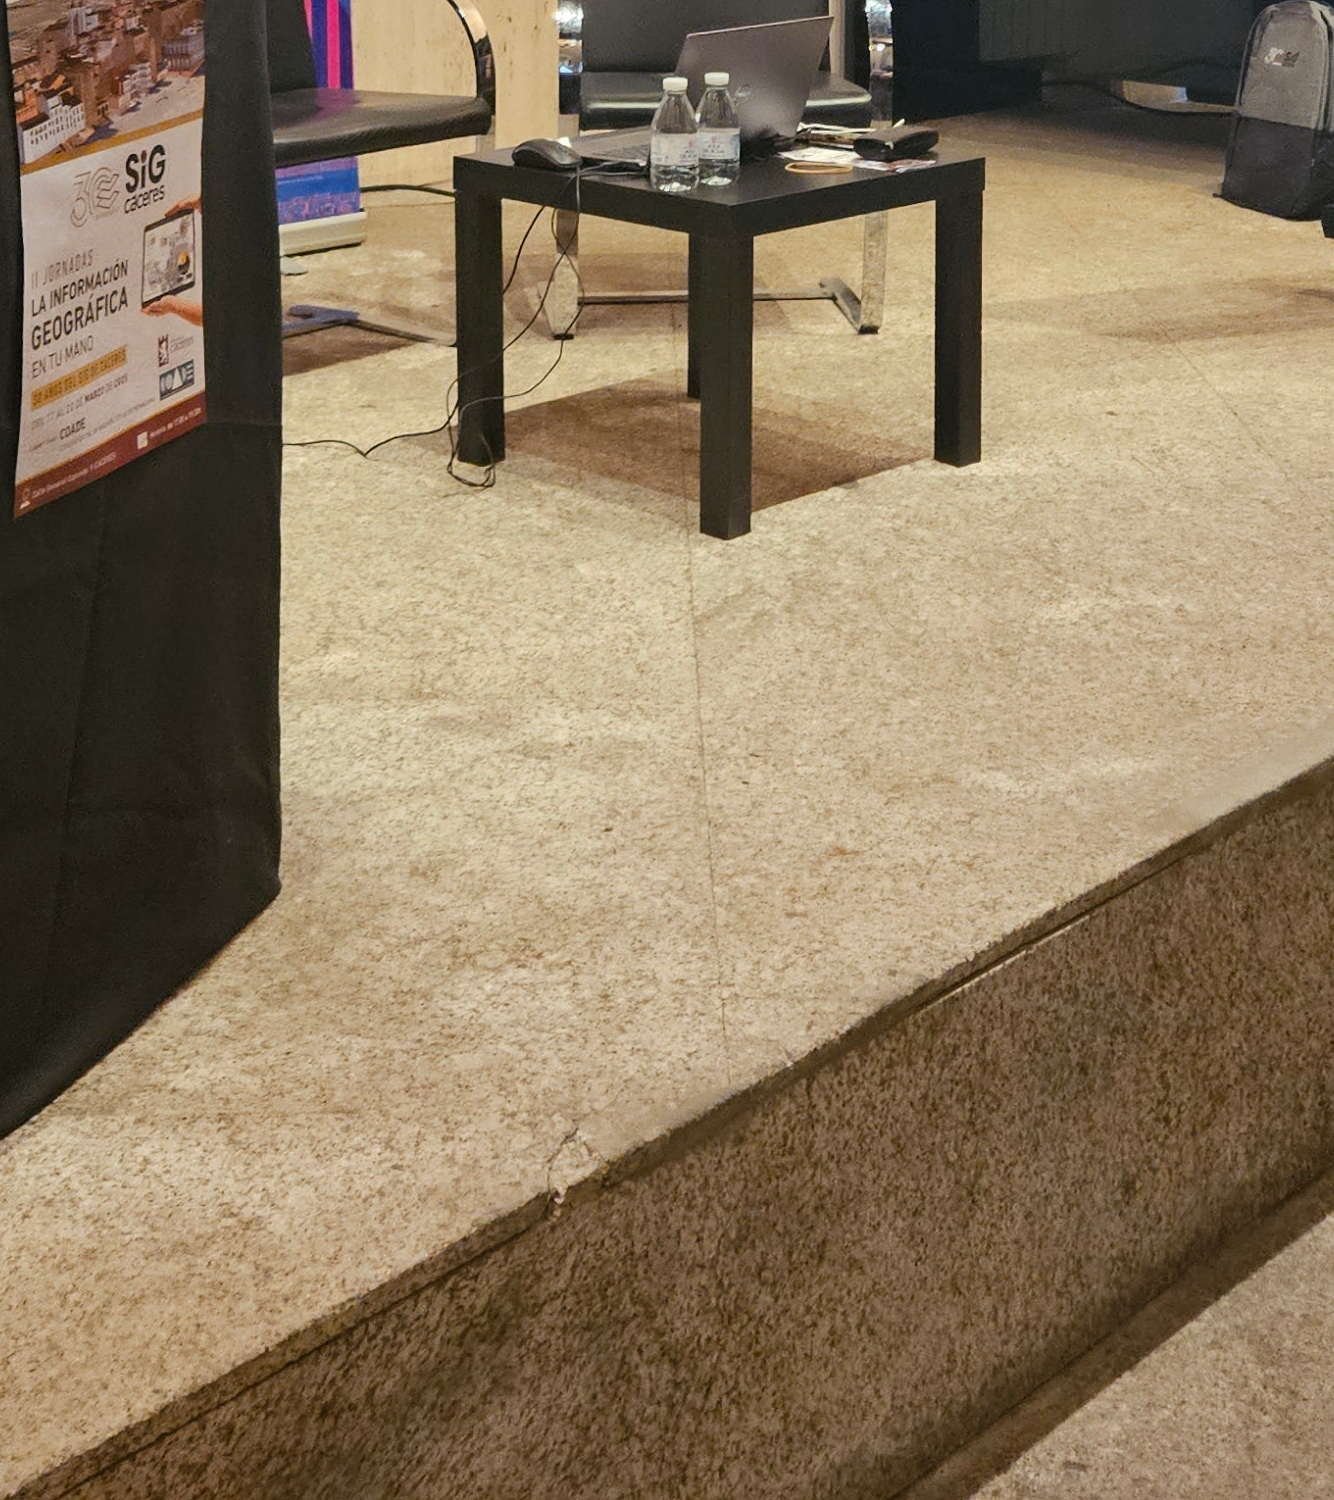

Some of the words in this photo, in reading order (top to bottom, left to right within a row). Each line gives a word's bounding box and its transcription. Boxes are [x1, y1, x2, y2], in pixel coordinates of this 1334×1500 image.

[31, 294, 47, 318] LA
[49, 258, 129, 309] INFORMACIÓN
[42, 249, 94, 286] JORNADAS
[31, 286, 129, 350] GEOGRÁFICA
[31, 356, 47, 379] EN
[49, 348, 62, 369] TU
[65, 335, 94, 362] MANO
[60, 417, 86, 440] COADE
